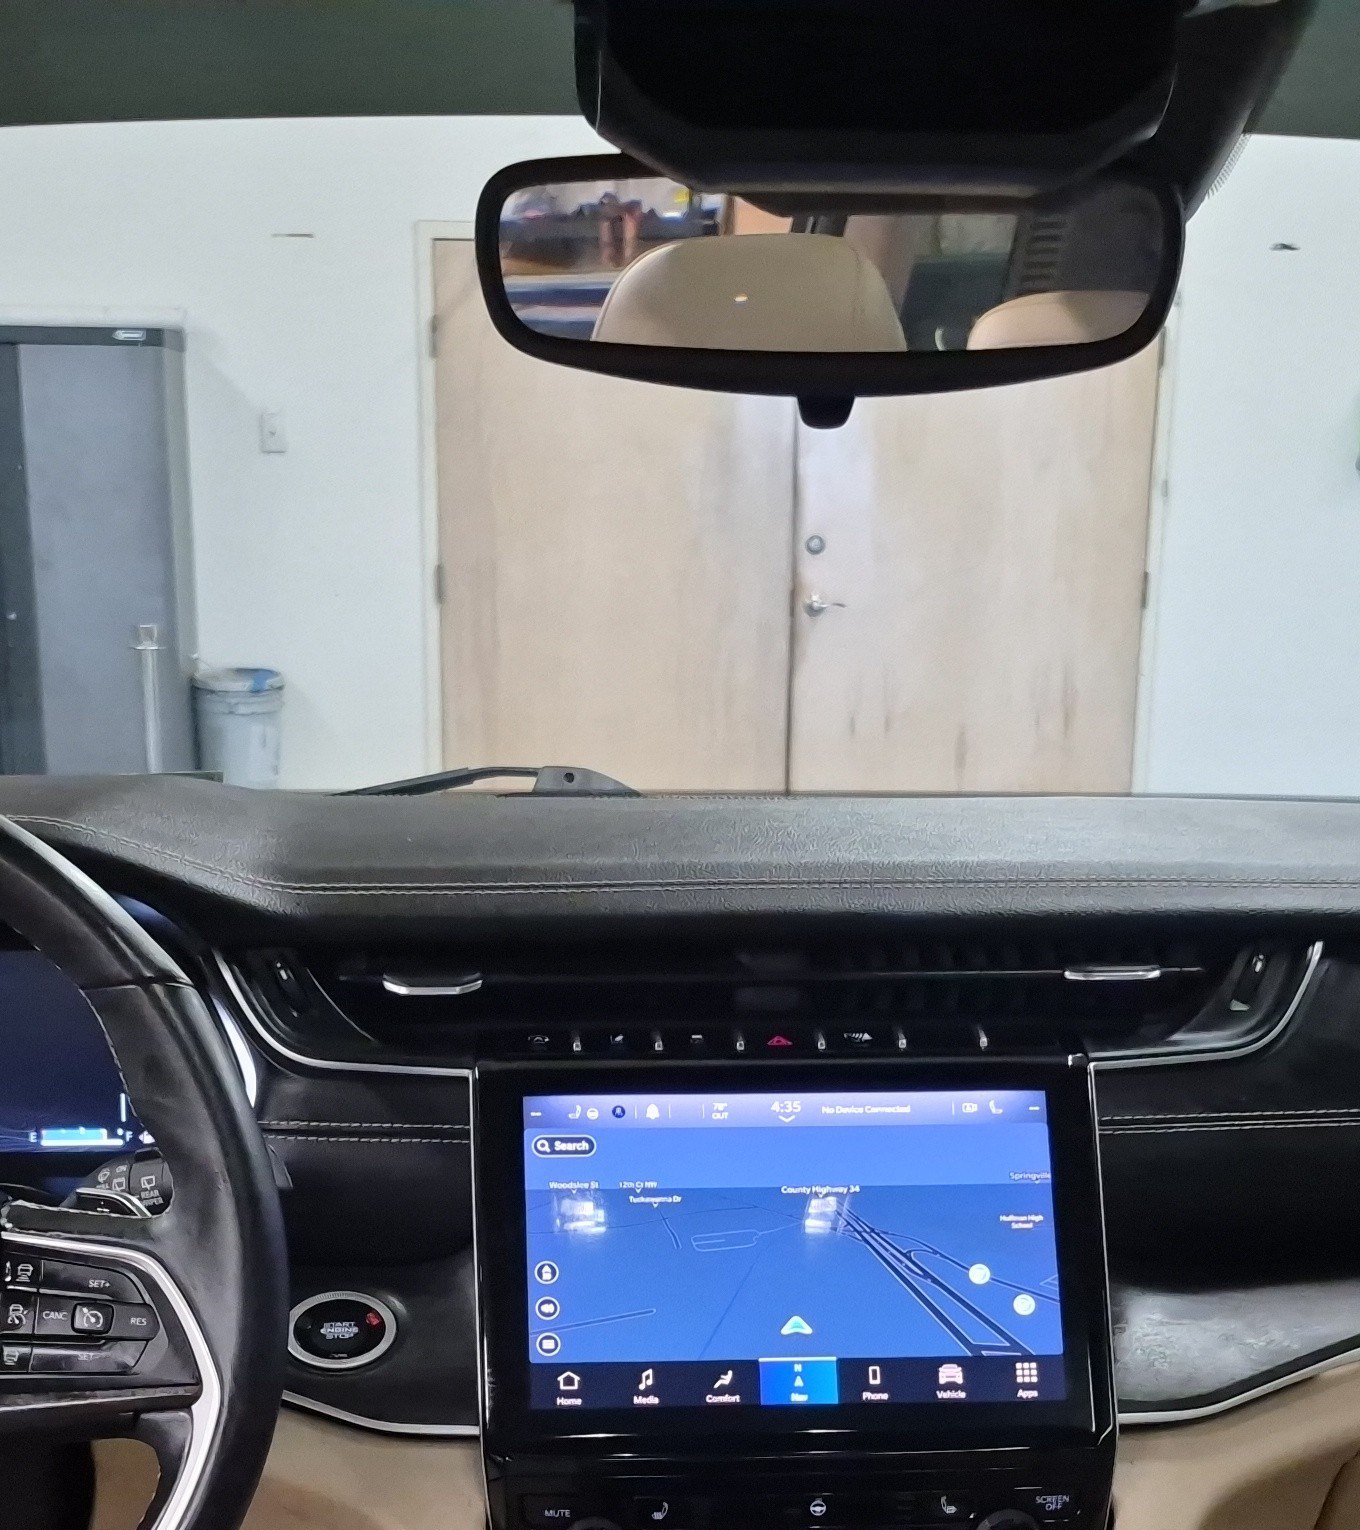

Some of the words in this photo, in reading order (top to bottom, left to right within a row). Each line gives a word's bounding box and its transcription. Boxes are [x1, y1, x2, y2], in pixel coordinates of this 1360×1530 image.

[770, 1101, 802, 1113] 4:35
[821, 1106, 835, 1114] No
[836, 1105, 864, 1114] Device
[865, 1105, 911, 1113] Connected
[554, 1141, 589, 1151] Search
[781, 1186, 810, 1195] County
[812, 1186, 847, 1195] Highway
[849, 1186, 860, 1194] 34
[43, 1311, 68, 1321] CANC
[130, 1317, 147, 1326] RES
[863, 1391, 889, 1401] Phone
[936, 1390, 967, 1399] Vehicle
[1017, 1389, 1038, 1399] Apps
[557, 1397, 582, 1405] Home
[633, 1395, 659, 1404] Media
[706, 1394, 740, 1404] Comfort
[1035, 1495, 1070, 1503] SCREEN
[1045, 1502, 1062, 1511] OFF
[544, 1509, 571, 1518] MUTE
